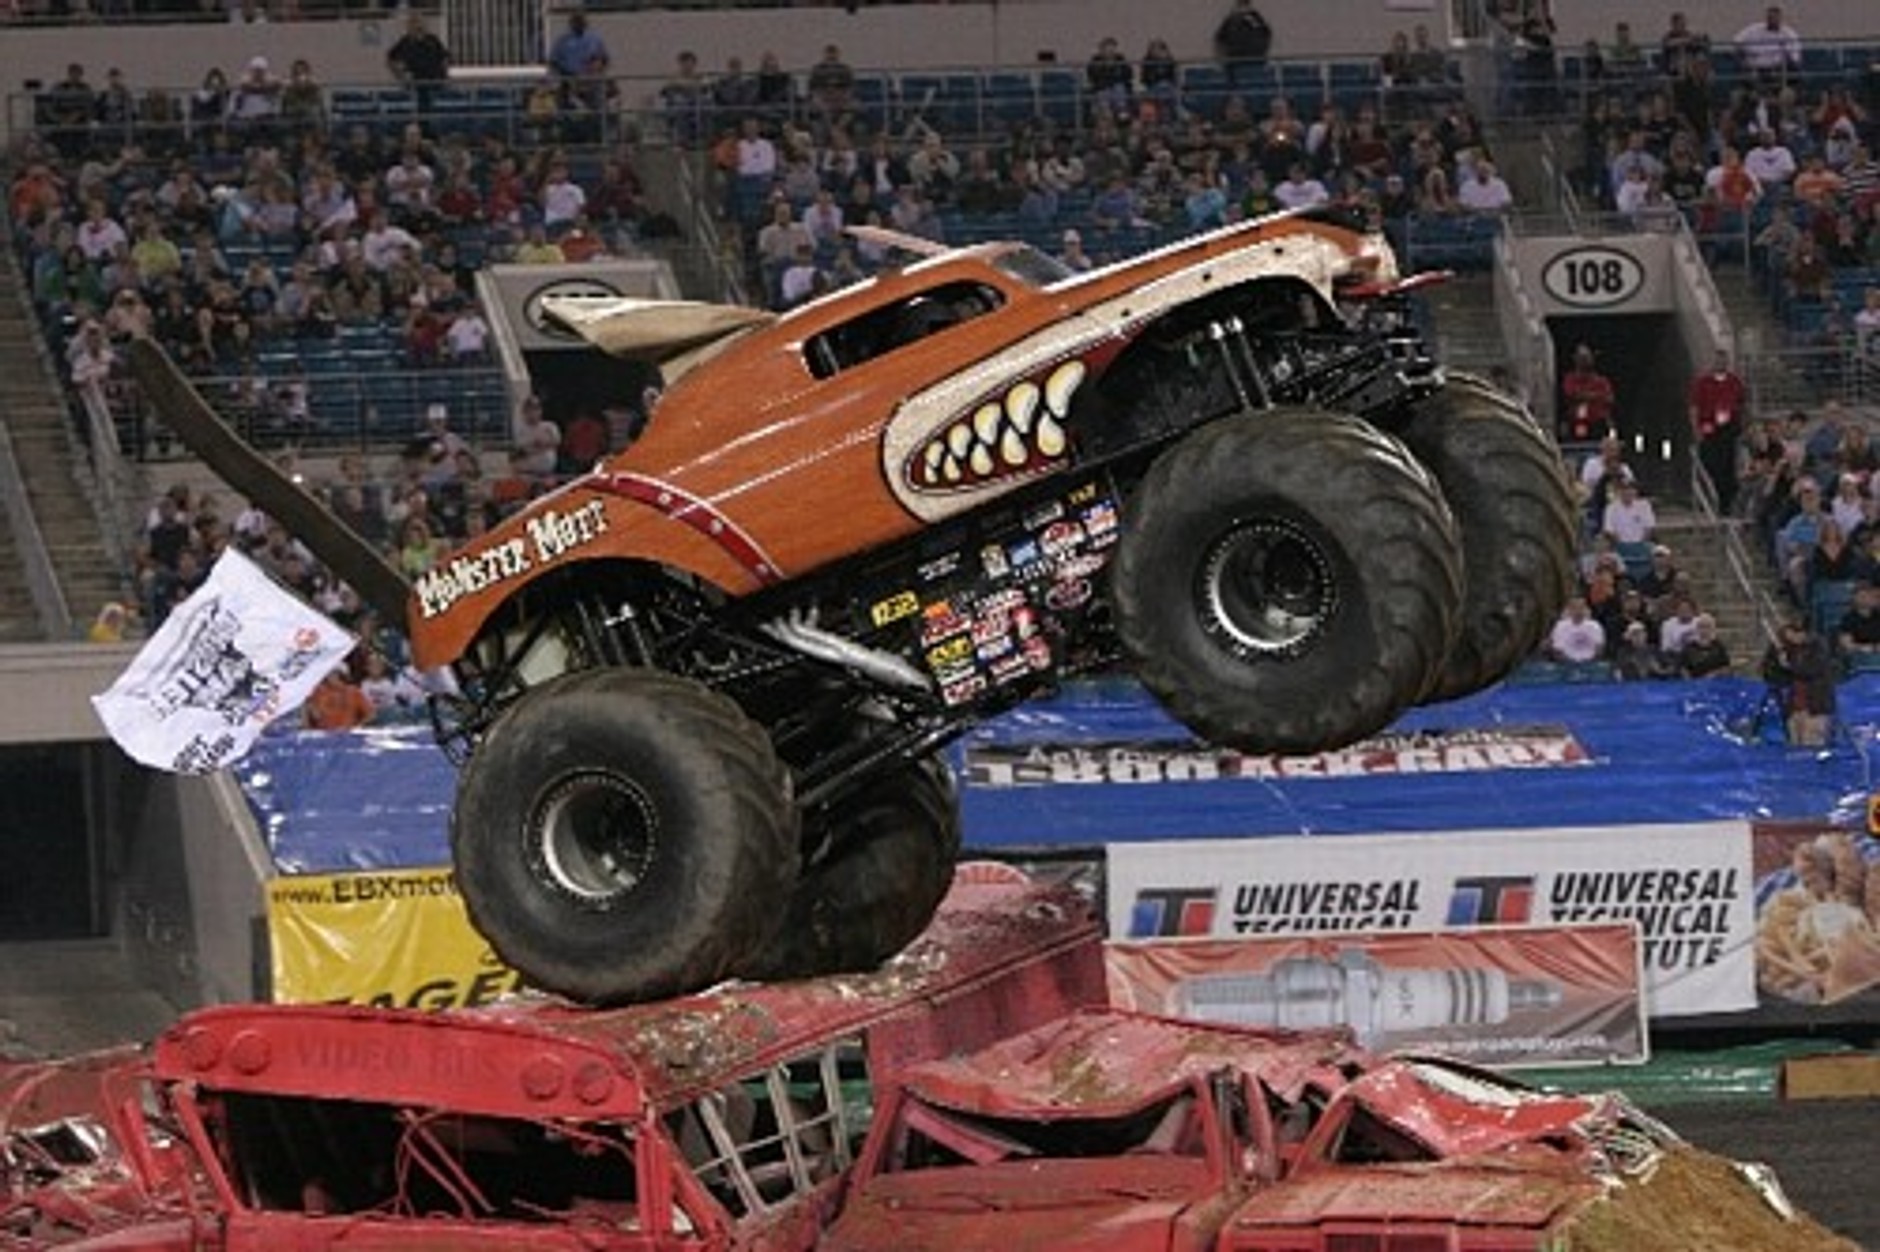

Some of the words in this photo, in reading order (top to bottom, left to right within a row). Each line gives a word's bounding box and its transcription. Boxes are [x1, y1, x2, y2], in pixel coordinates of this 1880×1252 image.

[1564, 259, 1624, 295] 108
[1233, 880, 1420, 915] UNIVERSAL
[1552, 869, 1738, 904] UNIVERSAL
